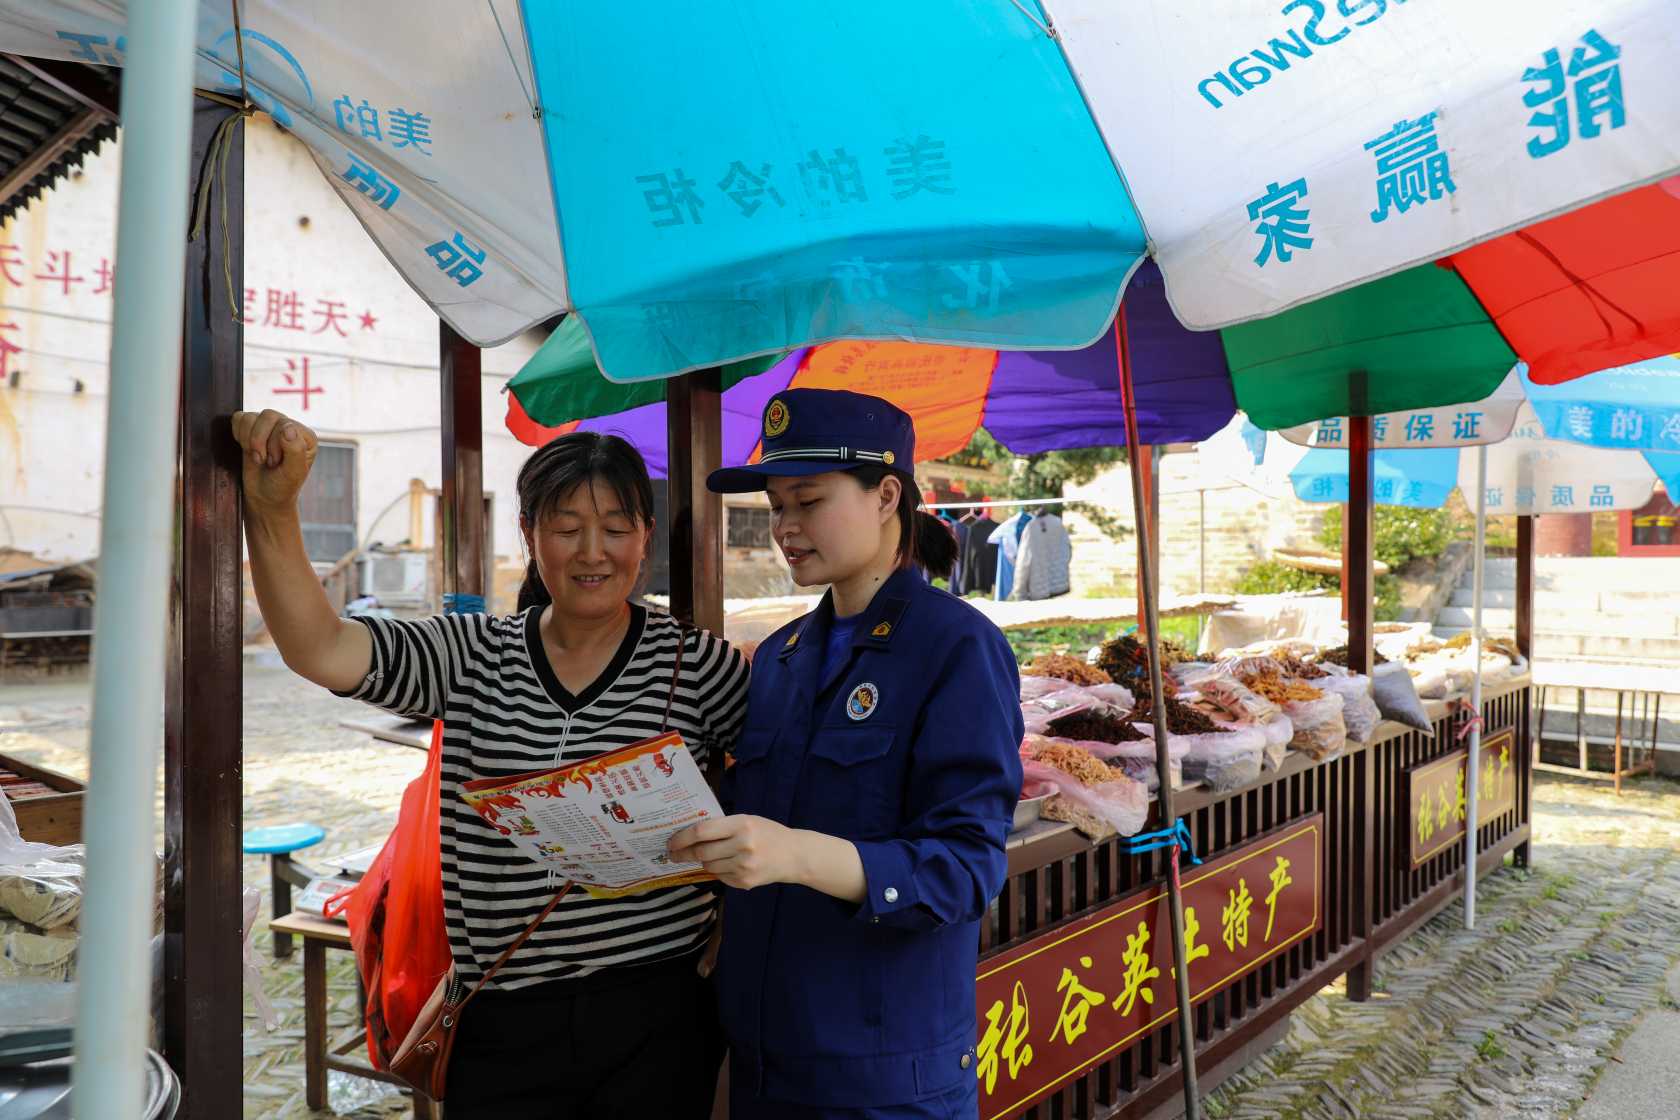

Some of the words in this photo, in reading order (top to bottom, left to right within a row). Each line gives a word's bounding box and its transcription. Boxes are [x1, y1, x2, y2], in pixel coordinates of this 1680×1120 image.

[1417, 744, 1510, 846] 张谷英特产
